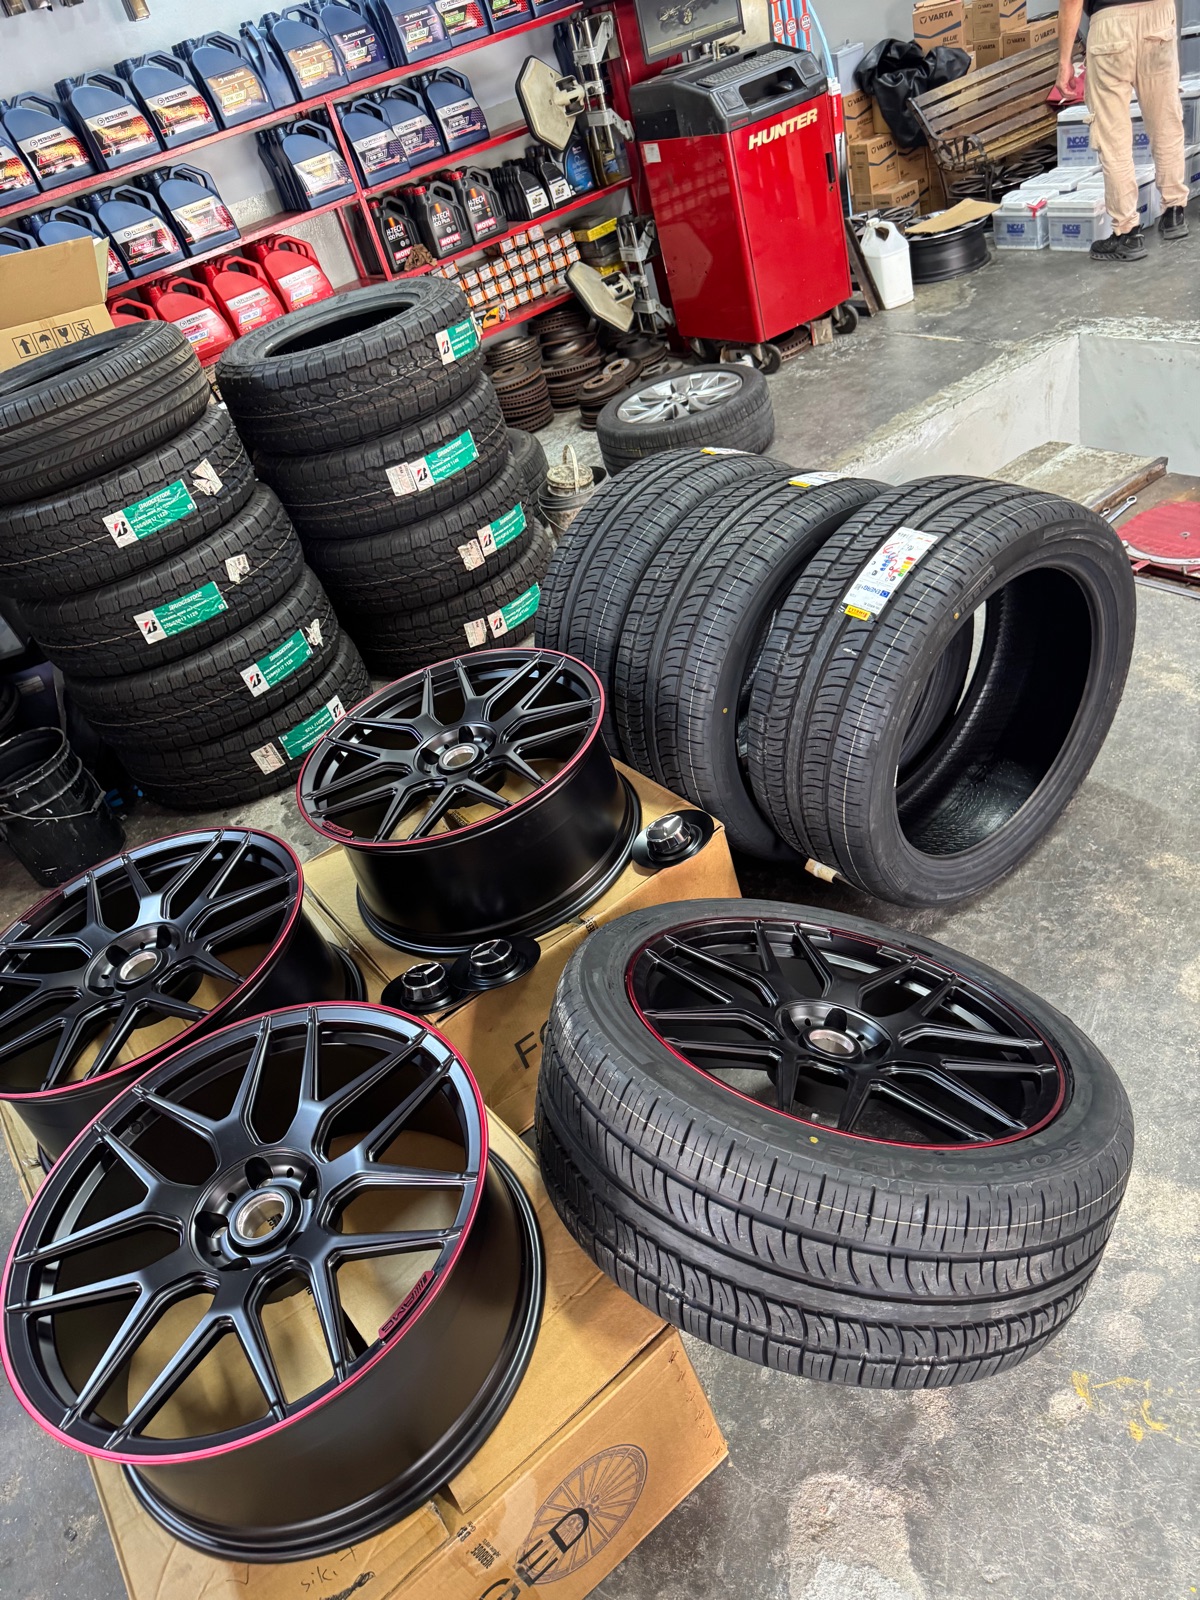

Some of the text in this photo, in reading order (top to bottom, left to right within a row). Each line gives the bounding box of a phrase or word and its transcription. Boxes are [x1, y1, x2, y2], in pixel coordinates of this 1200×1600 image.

[928, 10, 953, 21] VARTA
[942, 34, 958, 42] BLUE
[1039, 28, 1056, 39] VARTA
[748, 107, 818, 151] HUNTER
[876, 141, 893, 151] VARTA
[1066, 135, 1089, 145] INCOE
[467, 195, 485, 207] H-TECH
[900, 189, 916, 201] VARTA
[431, 210, 450, 222] H-TECH
[441, 217, 451, 225] Plus
[386, 224, 403, 236] H-TECH
[476, 219, 495, 231] MOTUL
[388, 233, 396, 241] 100
[441, 234, 460, 246] MOTUL
[395, 247, 411, 259] MOTU
[901, 1139, 1082, 1177] SCORPION
